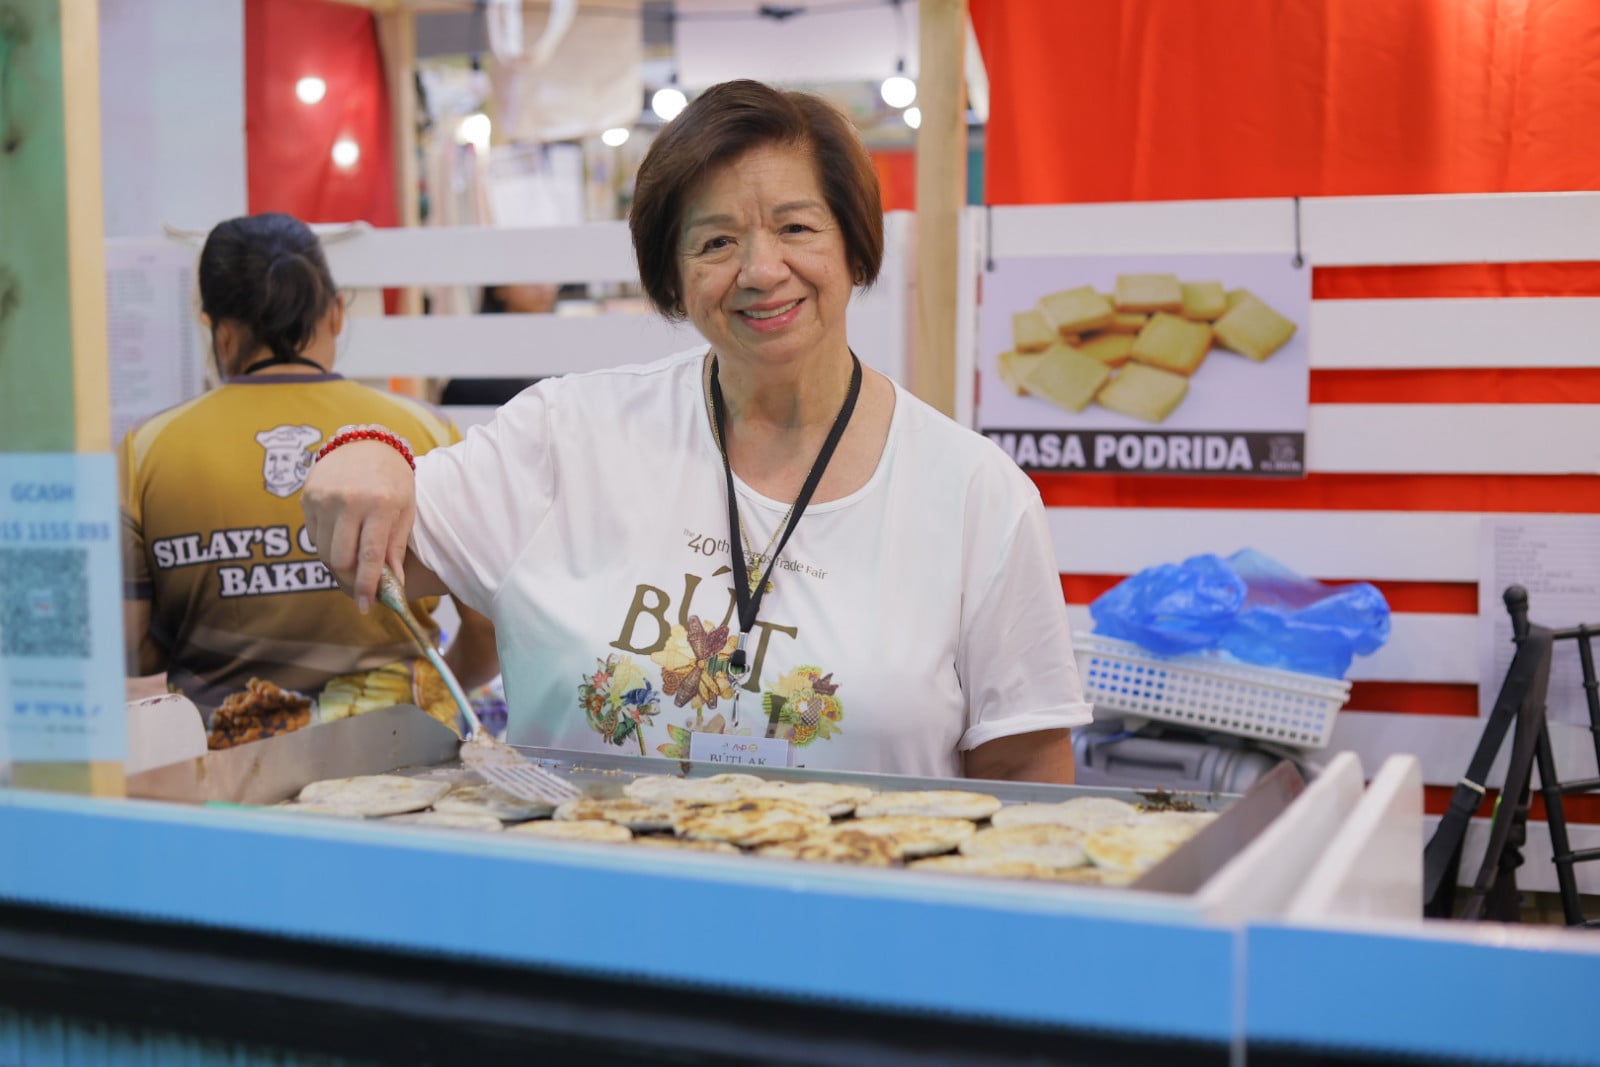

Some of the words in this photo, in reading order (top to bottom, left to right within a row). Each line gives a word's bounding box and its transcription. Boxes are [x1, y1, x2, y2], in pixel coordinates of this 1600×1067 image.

[1094, 434, 1253, 471] PODRIDA
[10, 482, 76, 503] GCASH
[153, 525, 291, 569] SILAY'S
[687, 533, 731, 557] 40th
[775, 556, 804, 573] Trade
[806, 565, 829, 580] Fair
[217, 559, 339, 598] BAKE
